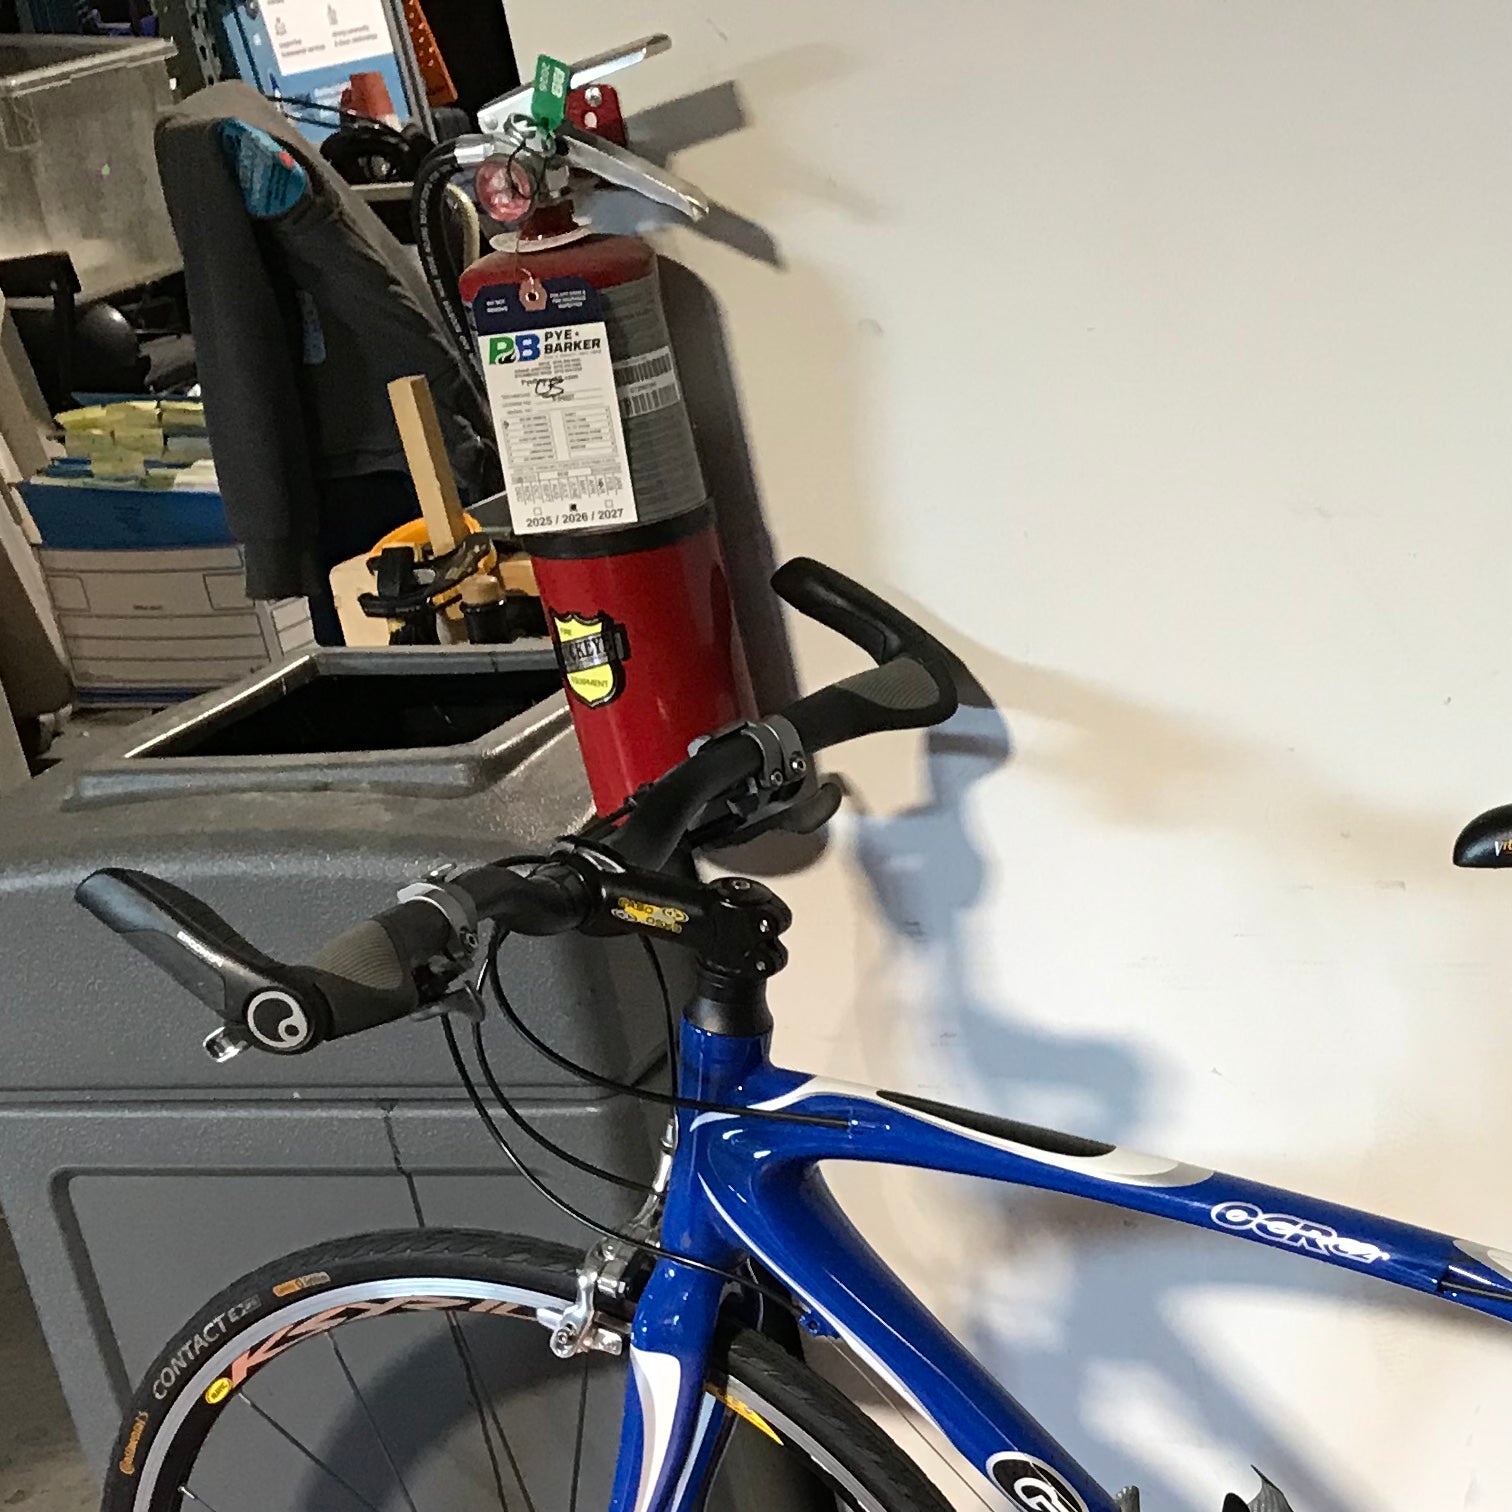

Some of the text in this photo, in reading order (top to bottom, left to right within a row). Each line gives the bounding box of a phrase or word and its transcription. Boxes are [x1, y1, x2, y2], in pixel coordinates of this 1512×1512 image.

[545, 329, 572, 341] PYE
[544, 338, 601, 354] BARKER
[526, 515, 553, 527] 2025
[562, 512, 589, 524] 2026
[598, 508, 624, 519] 2027
[152, 1316, 226, 1401] CONTACT
